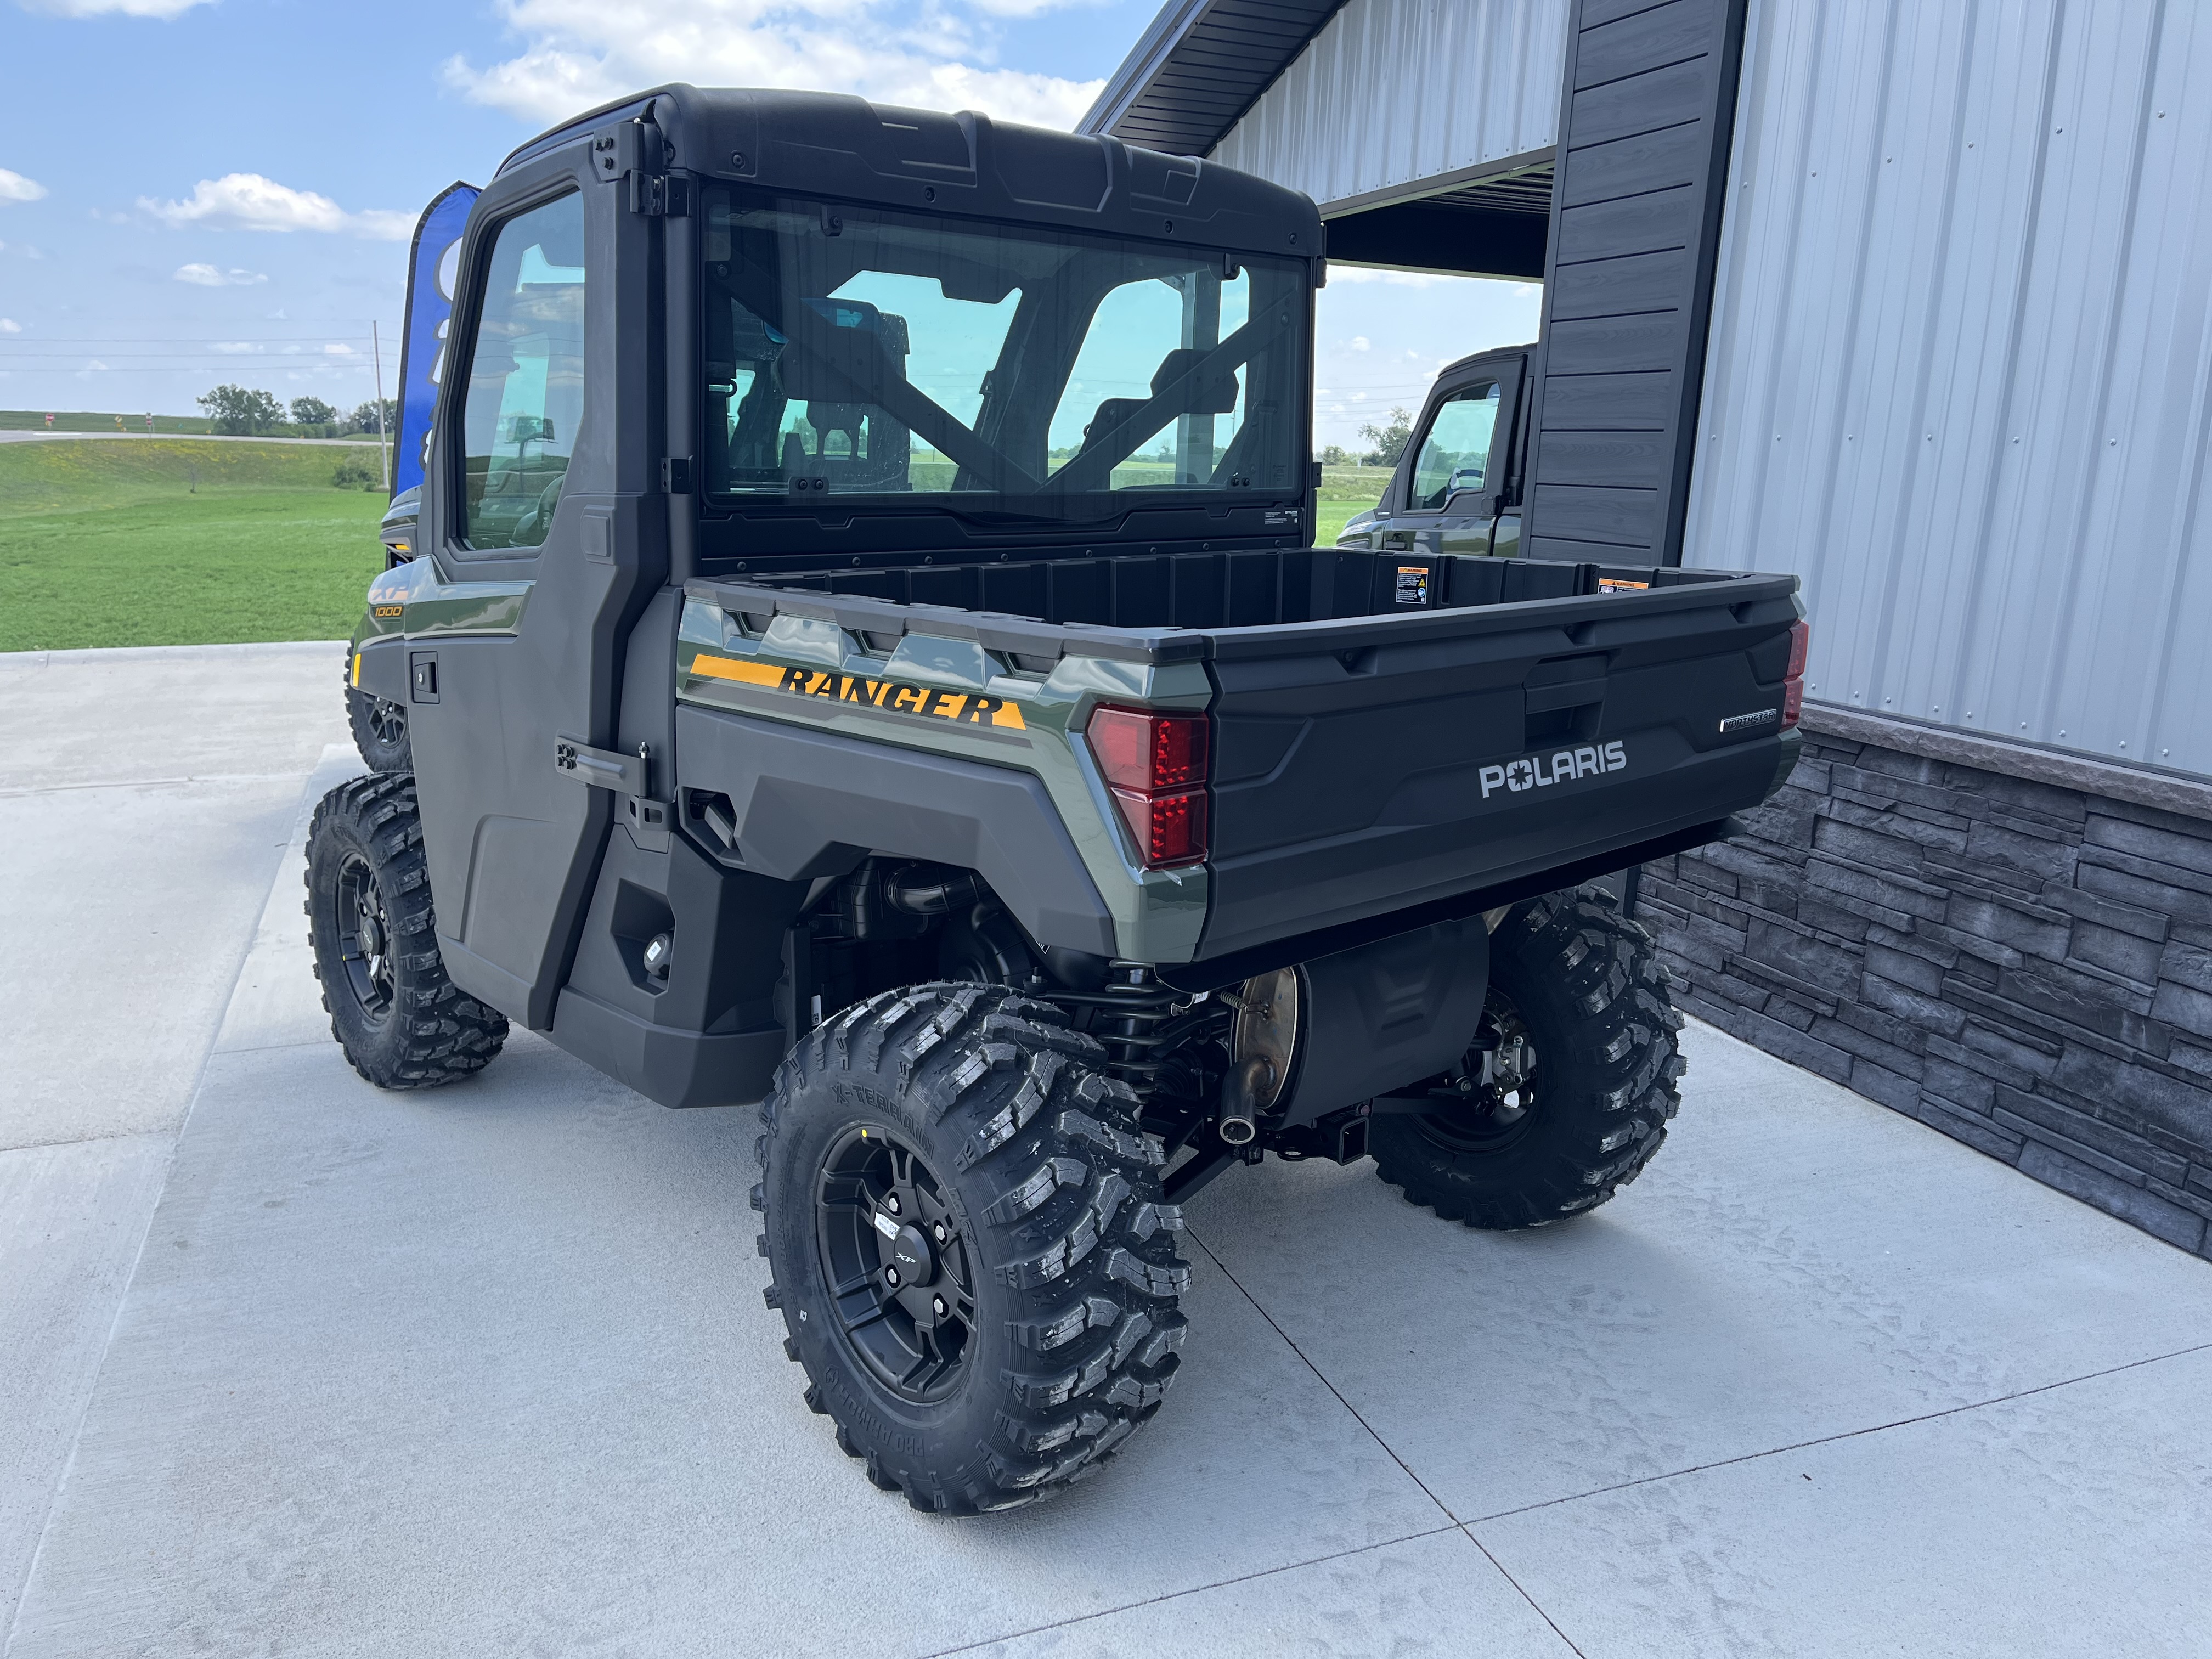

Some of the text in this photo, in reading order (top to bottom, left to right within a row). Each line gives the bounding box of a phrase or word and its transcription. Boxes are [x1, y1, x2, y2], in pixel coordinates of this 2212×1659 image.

[375, 606, 402, 617] 1000
[777, 667, 1003, 727] RANGER
[1724, 712, 1774, 729] NORTHSTAR
[1479, 741, 1627, 798] POLARIS
[830, 1083, 934, 1160] X-TERRAIN
[895, 1252, 916, 1263] XP
